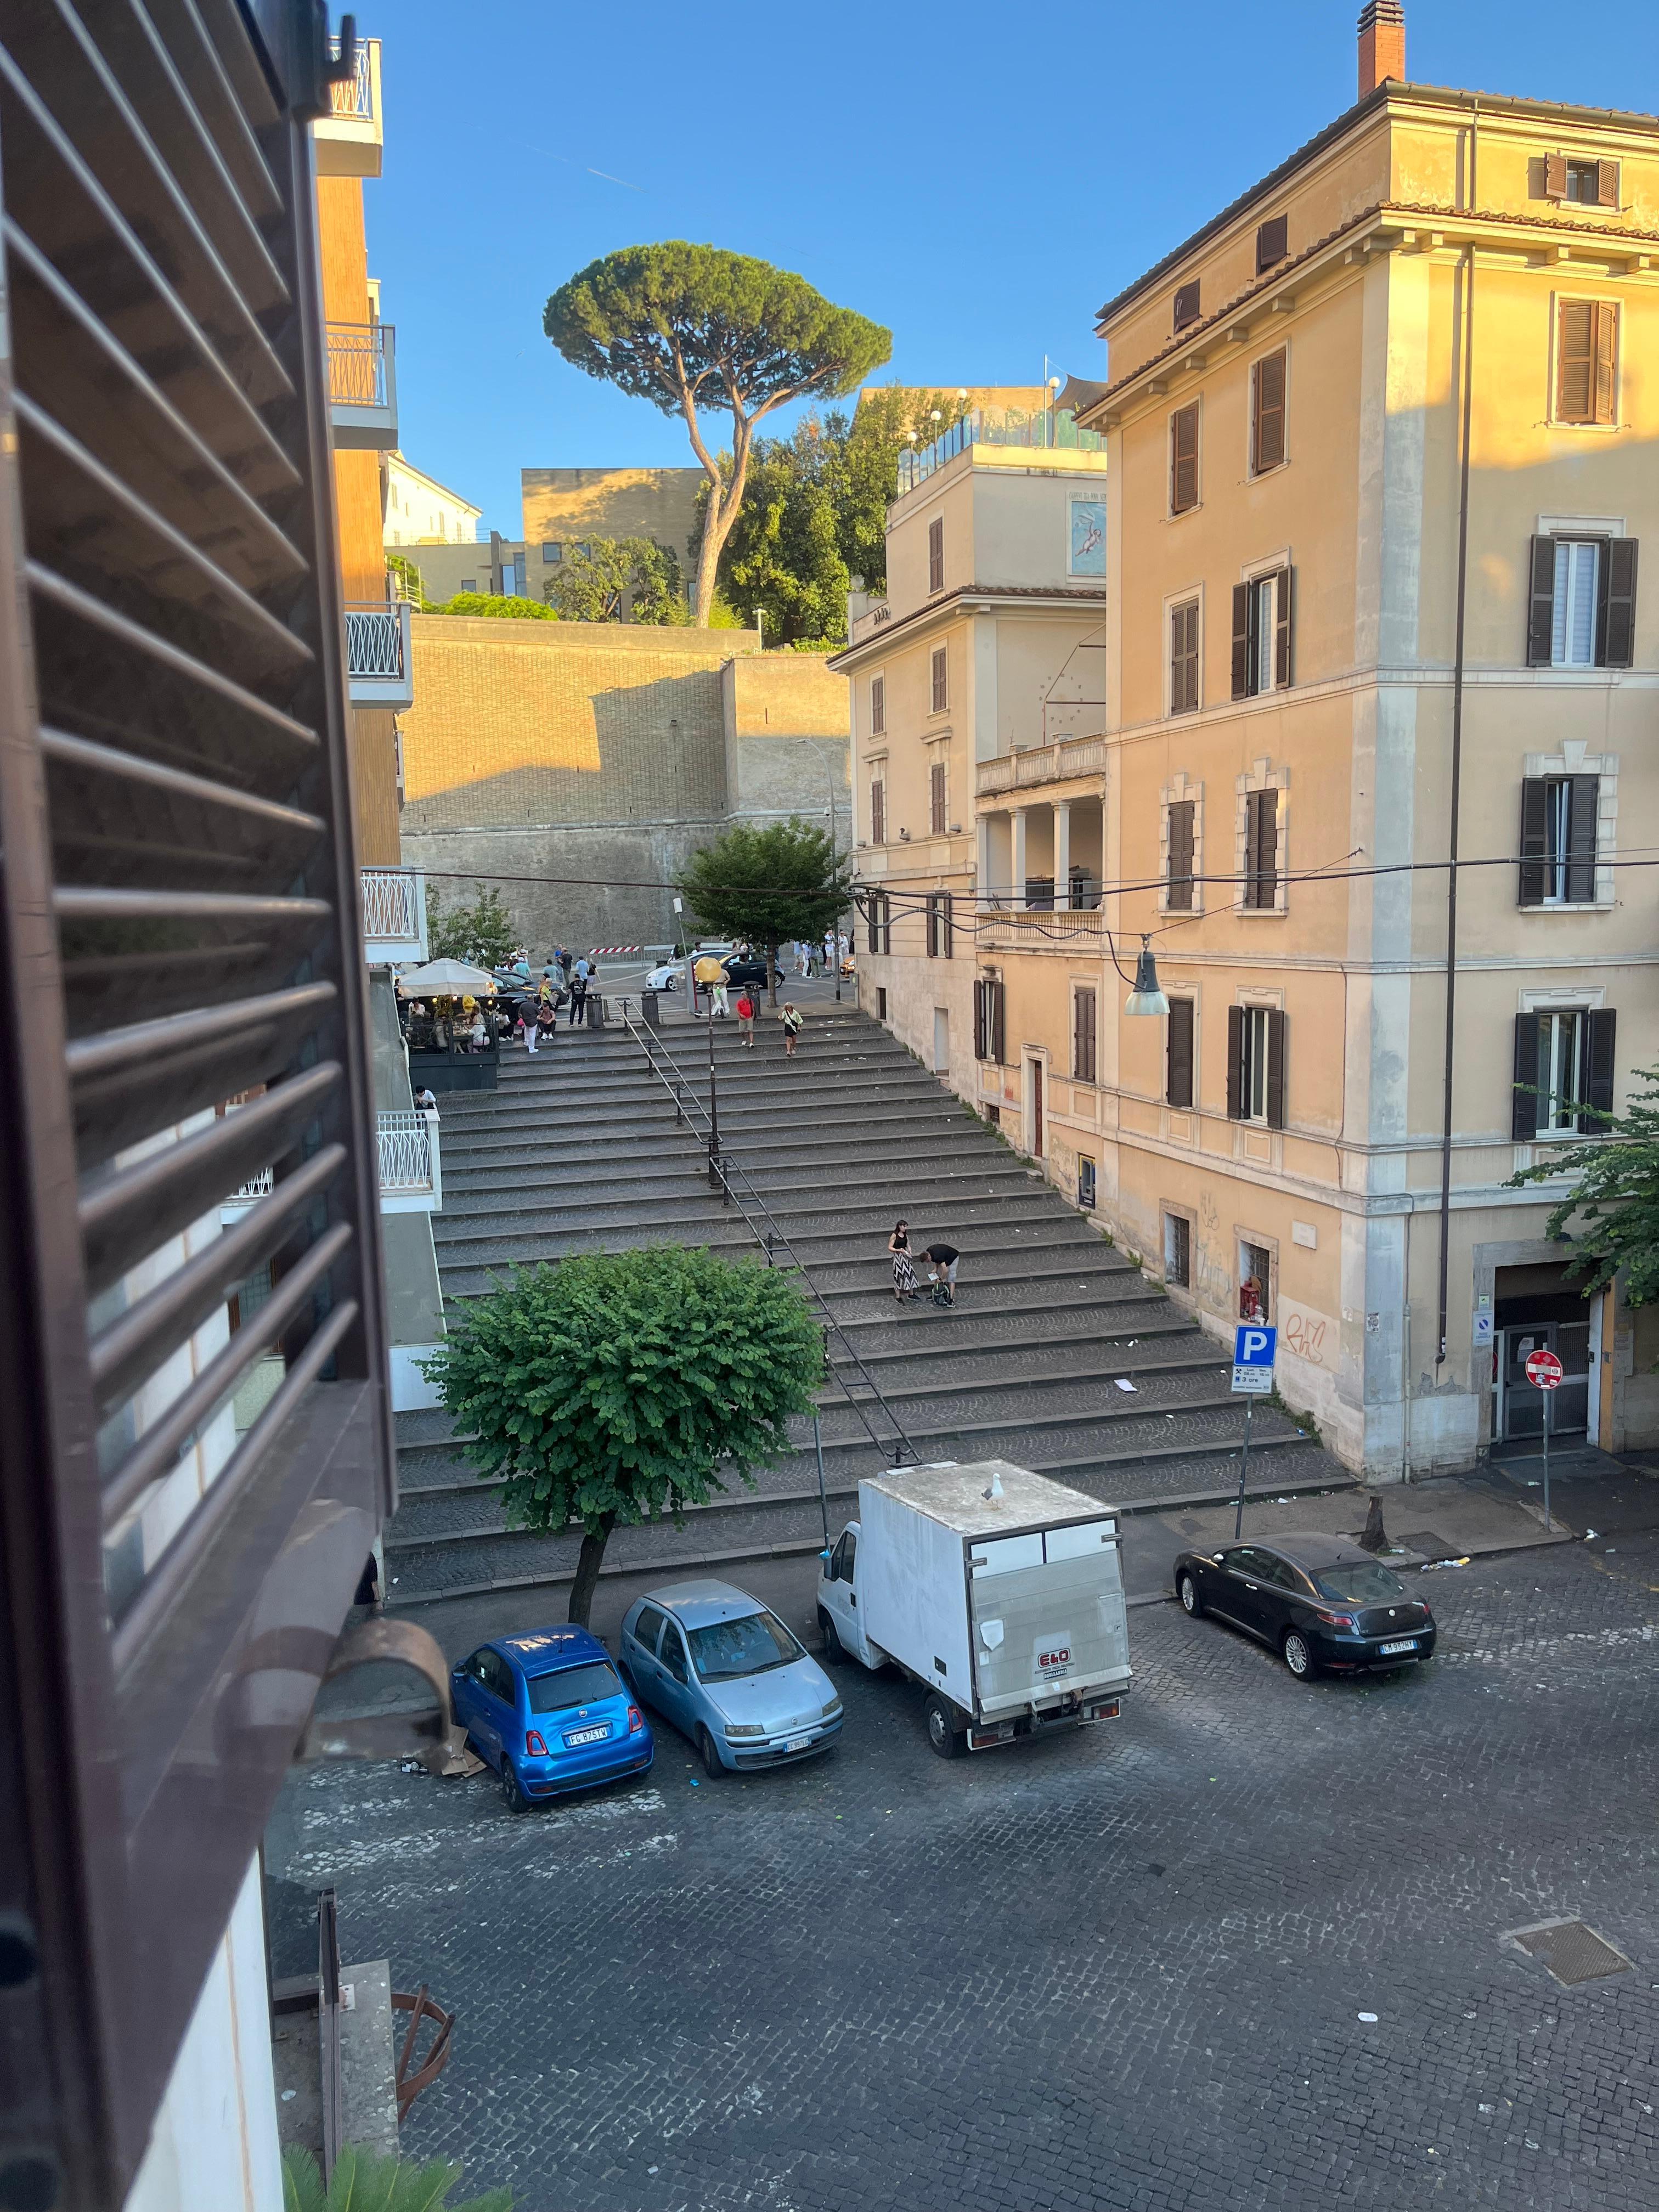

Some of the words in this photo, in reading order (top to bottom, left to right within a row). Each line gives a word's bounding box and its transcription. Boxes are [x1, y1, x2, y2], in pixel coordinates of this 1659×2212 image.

[1243, 1331, 1267, 1361] P
[1383, 1644, 1392, 1652] CM
[1393, 1640, 1413, 1651] 932HY
[571, 1735, 581, 1744] FG
[583, 1728, 606, 1741] 875TW
